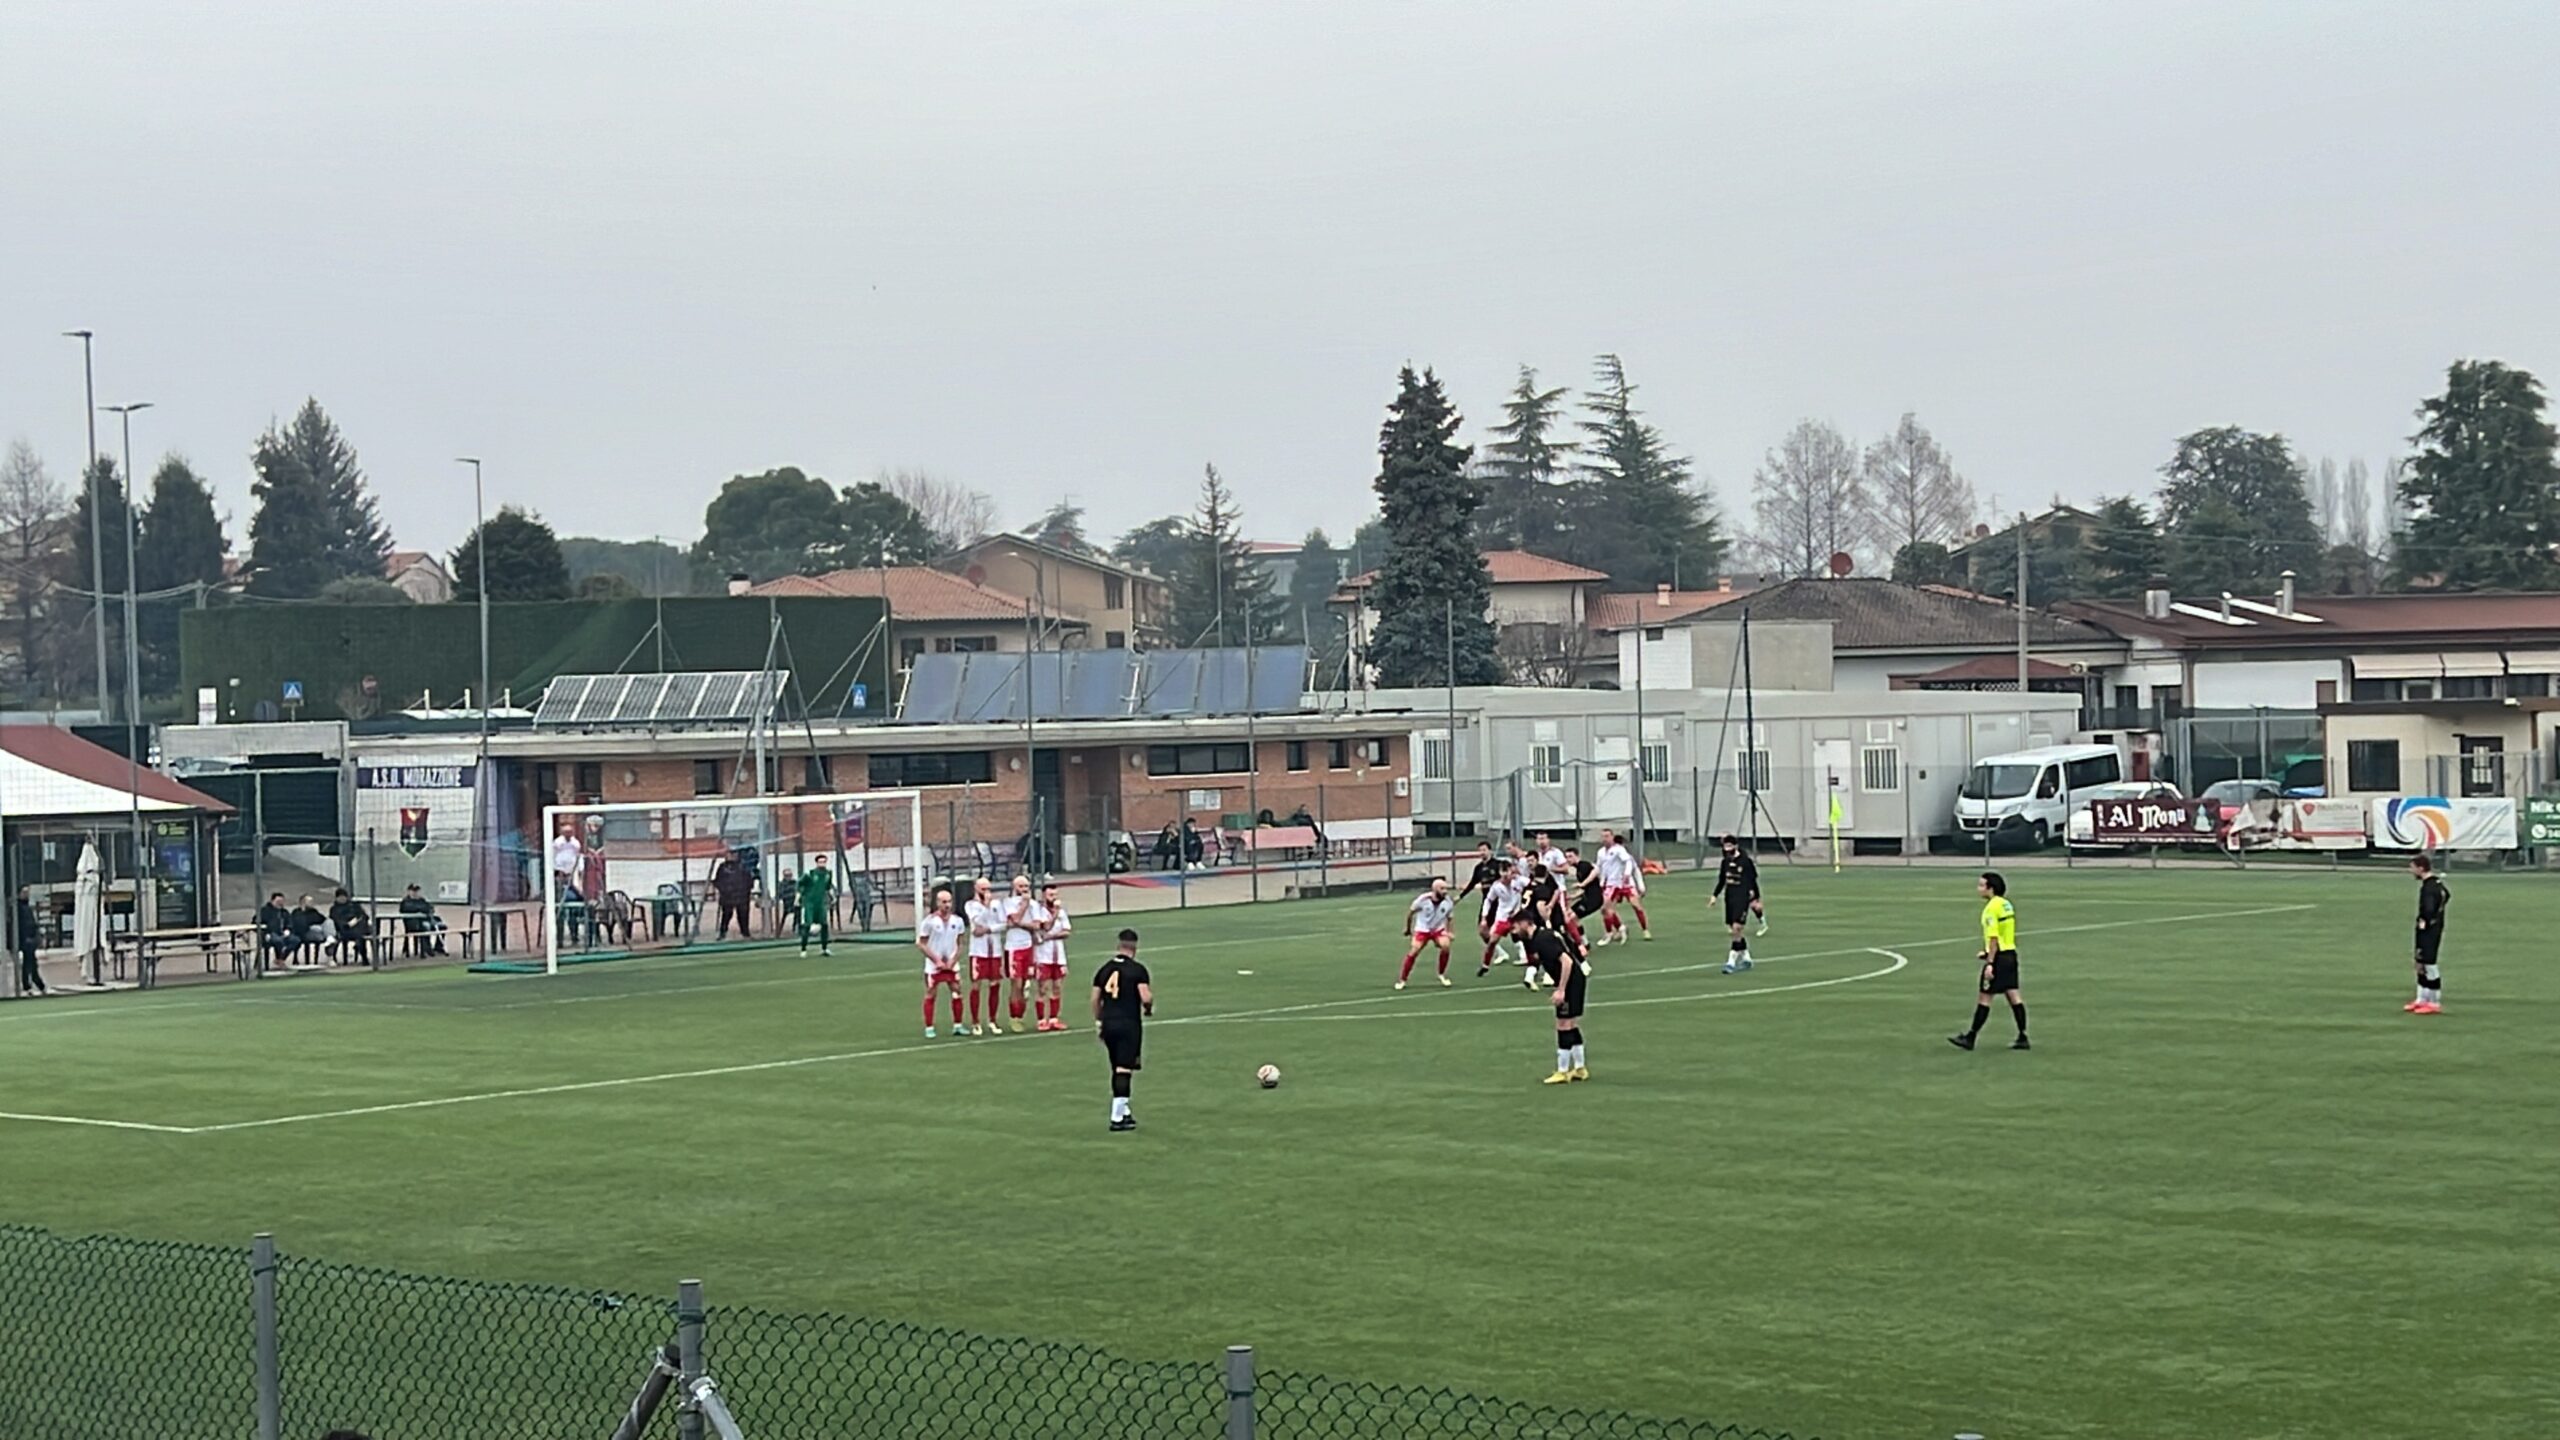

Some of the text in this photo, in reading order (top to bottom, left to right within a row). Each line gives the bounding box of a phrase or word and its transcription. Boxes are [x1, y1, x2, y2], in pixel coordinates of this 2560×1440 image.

[403, 767, 462, 787] MORAZZONE
[2107, 803, 2134, 828] Al
[1104, 970, 1120, 999] 4
